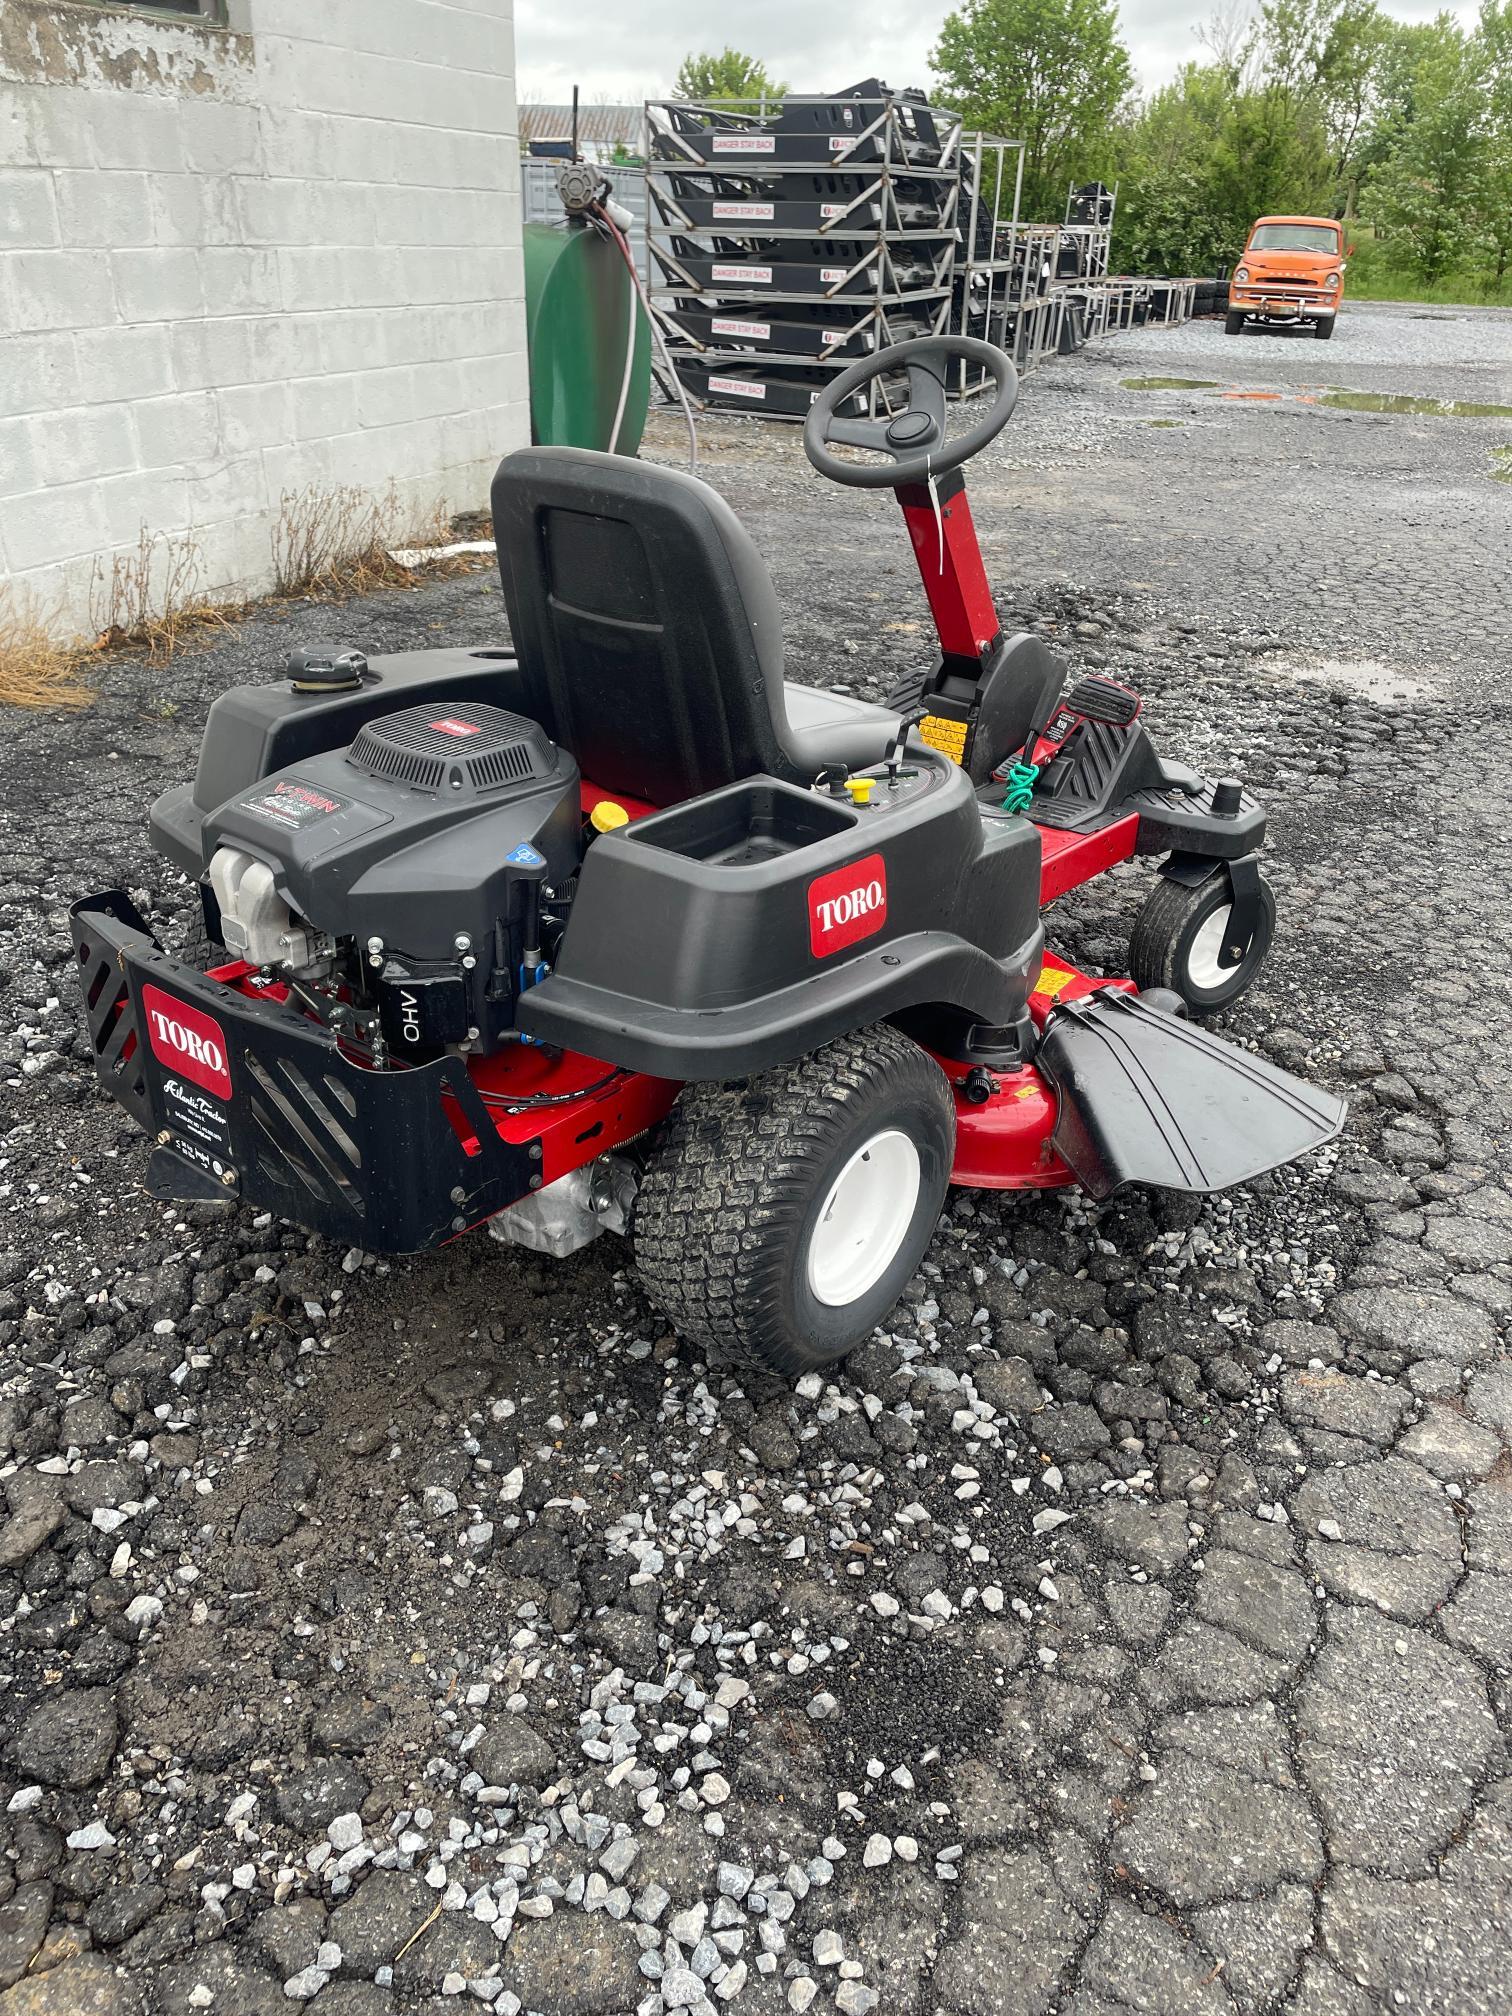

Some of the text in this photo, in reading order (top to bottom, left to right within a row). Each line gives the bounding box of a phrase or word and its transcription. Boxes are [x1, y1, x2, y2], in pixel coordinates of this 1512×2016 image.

[713, 140, 773, 148] DANGER STAY BACK
[713, 206, 772, 215] DANGER STAY BACK
[712, 268, 770, 278] DANGER STAY BACK
[712, 322, 768, 335] DANGER STAY BACK
[709, 380, 764, 394] DANGER STAY BACK
[817, 881, 882, 932] TORO
[400, 989, 420, 1042] OHV
[151, 1009, 223, 1072] TORO
[196, 1097, 227, 1125] Tractor
